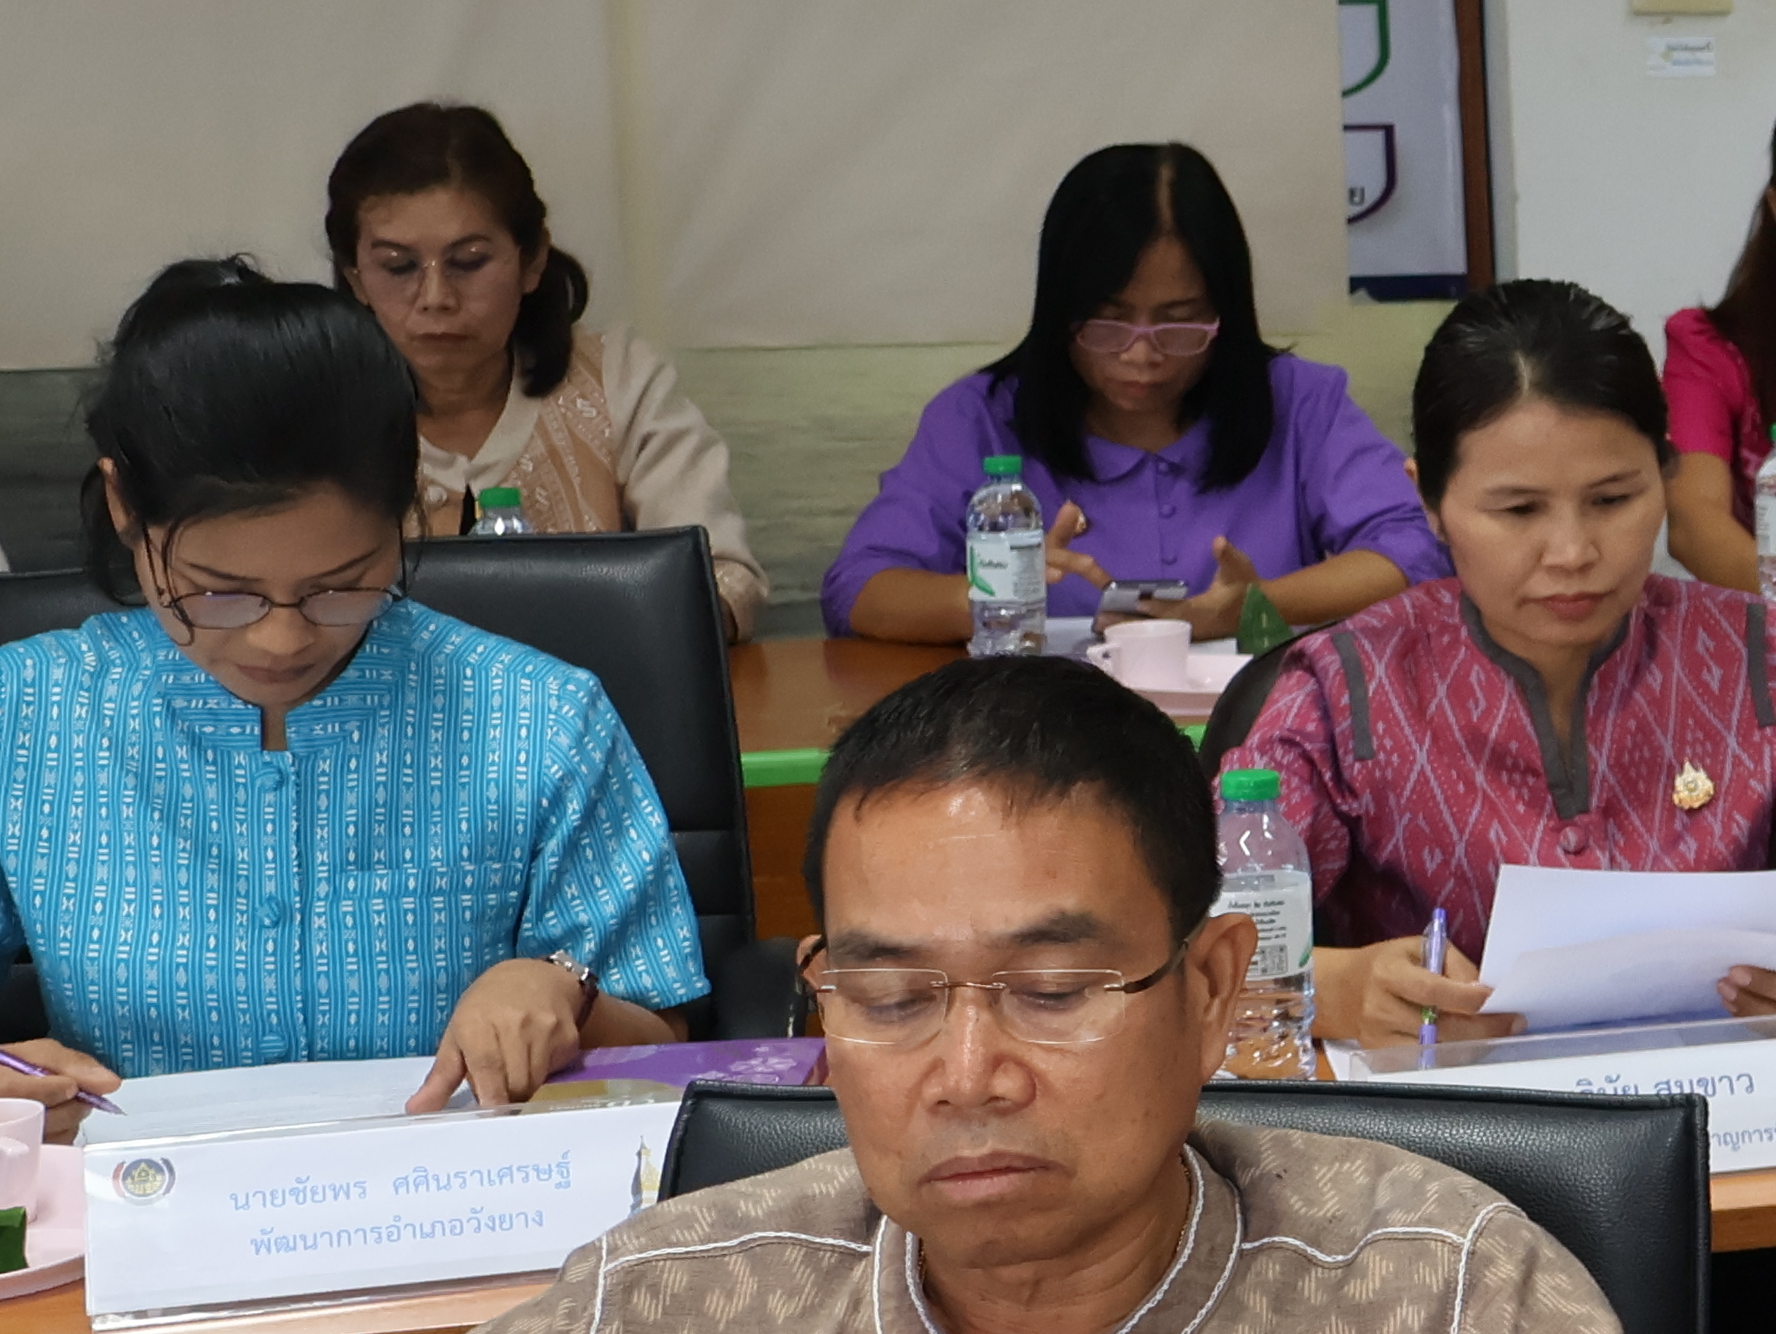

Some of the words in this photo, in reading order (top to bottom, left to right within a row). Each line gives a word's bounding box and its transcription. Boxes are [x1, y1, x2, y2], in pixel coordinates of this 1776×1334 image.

[229, 1174, 368, 1214] นายชัยพร
[249, 1207, 546, 1257] พัฒนาการอำเภอวังยาง
